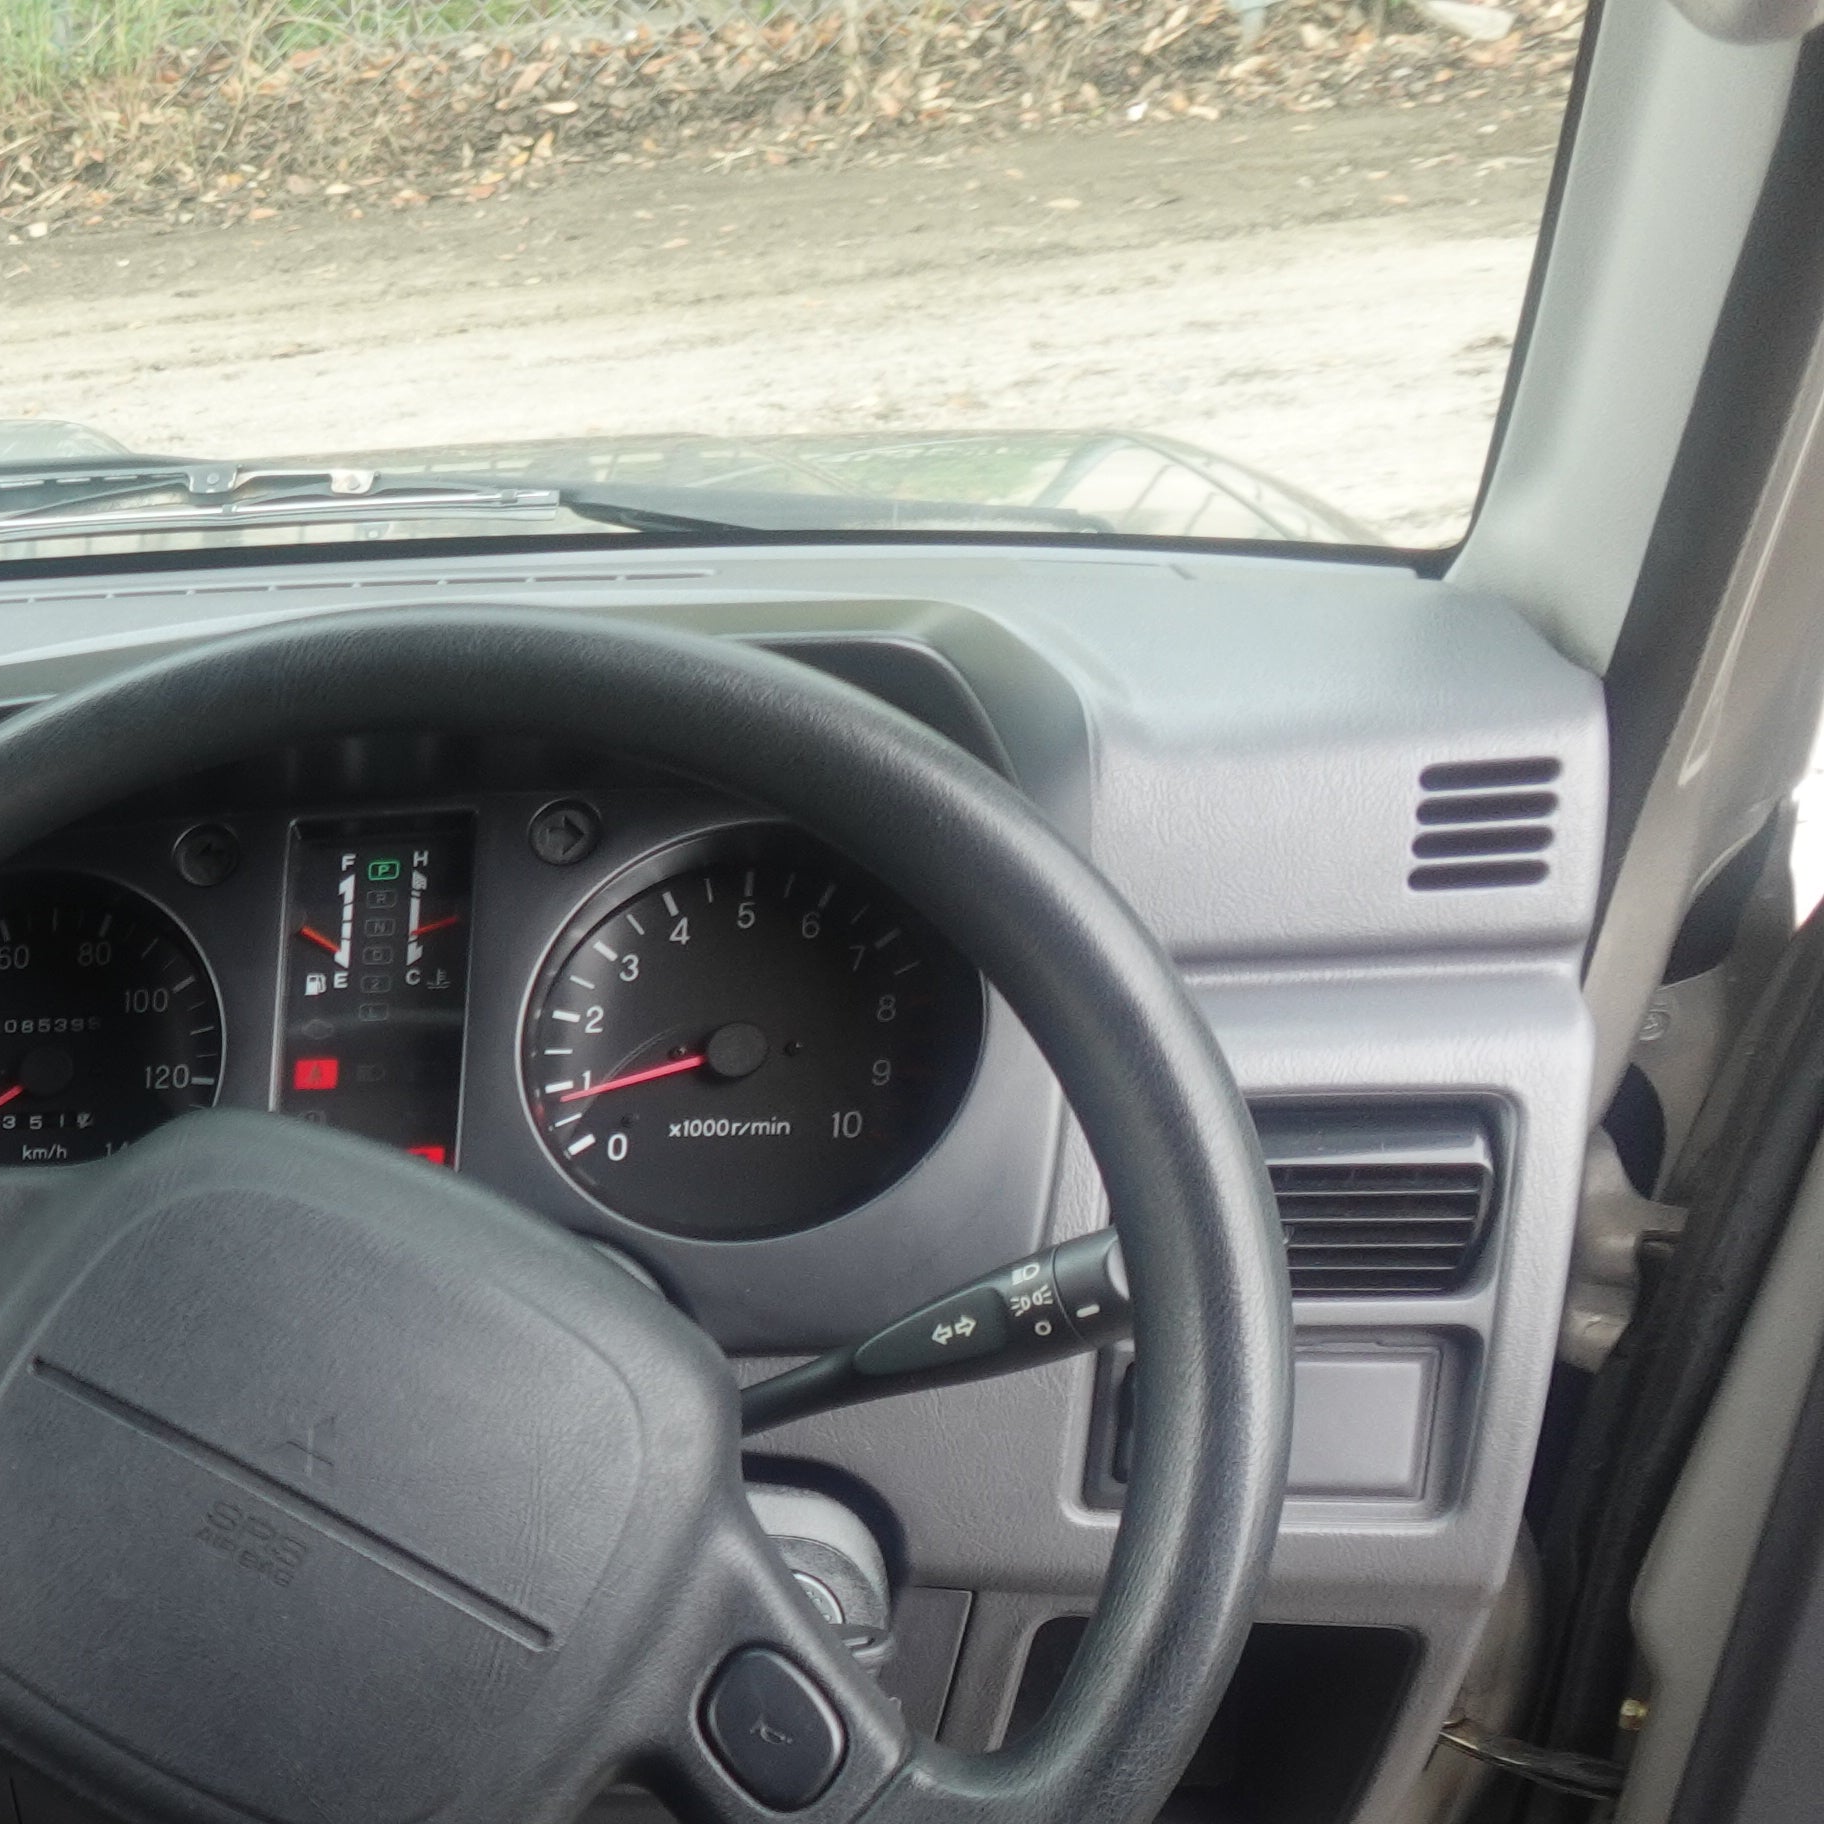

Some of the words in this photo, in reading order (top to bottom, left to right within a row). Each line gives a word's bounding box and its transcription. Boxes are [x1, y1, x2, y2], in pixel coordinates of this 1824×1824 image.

[341, 853, 356, 871] F
[413, 850, 430, 868] H
[737, 902, 756, 929] 5
[802, 911, 820, 939] 6
[669, 916, 691, 945] 4
[77, 942, 111, 966] 80
[849, 945, 866, 972] 7
[333, 971, 349, 989] E
[405, 969, 422, 986] C
[619, 954, 640, 982] 3
[125, 988, 169, 1013] 100
[877, 994, 896, 1023] 8
[584, 1005, 604, 1034] 2
[144, 1065, 190, 1090] 120
[581, 1070, 591, 1091] 1
[872, 1058, 891, 1086] 9
[831, 1110, 863, 1139] 10
[22, 1144, 67, 1160] km/h
[607, 1132, 629, 1162] 0
